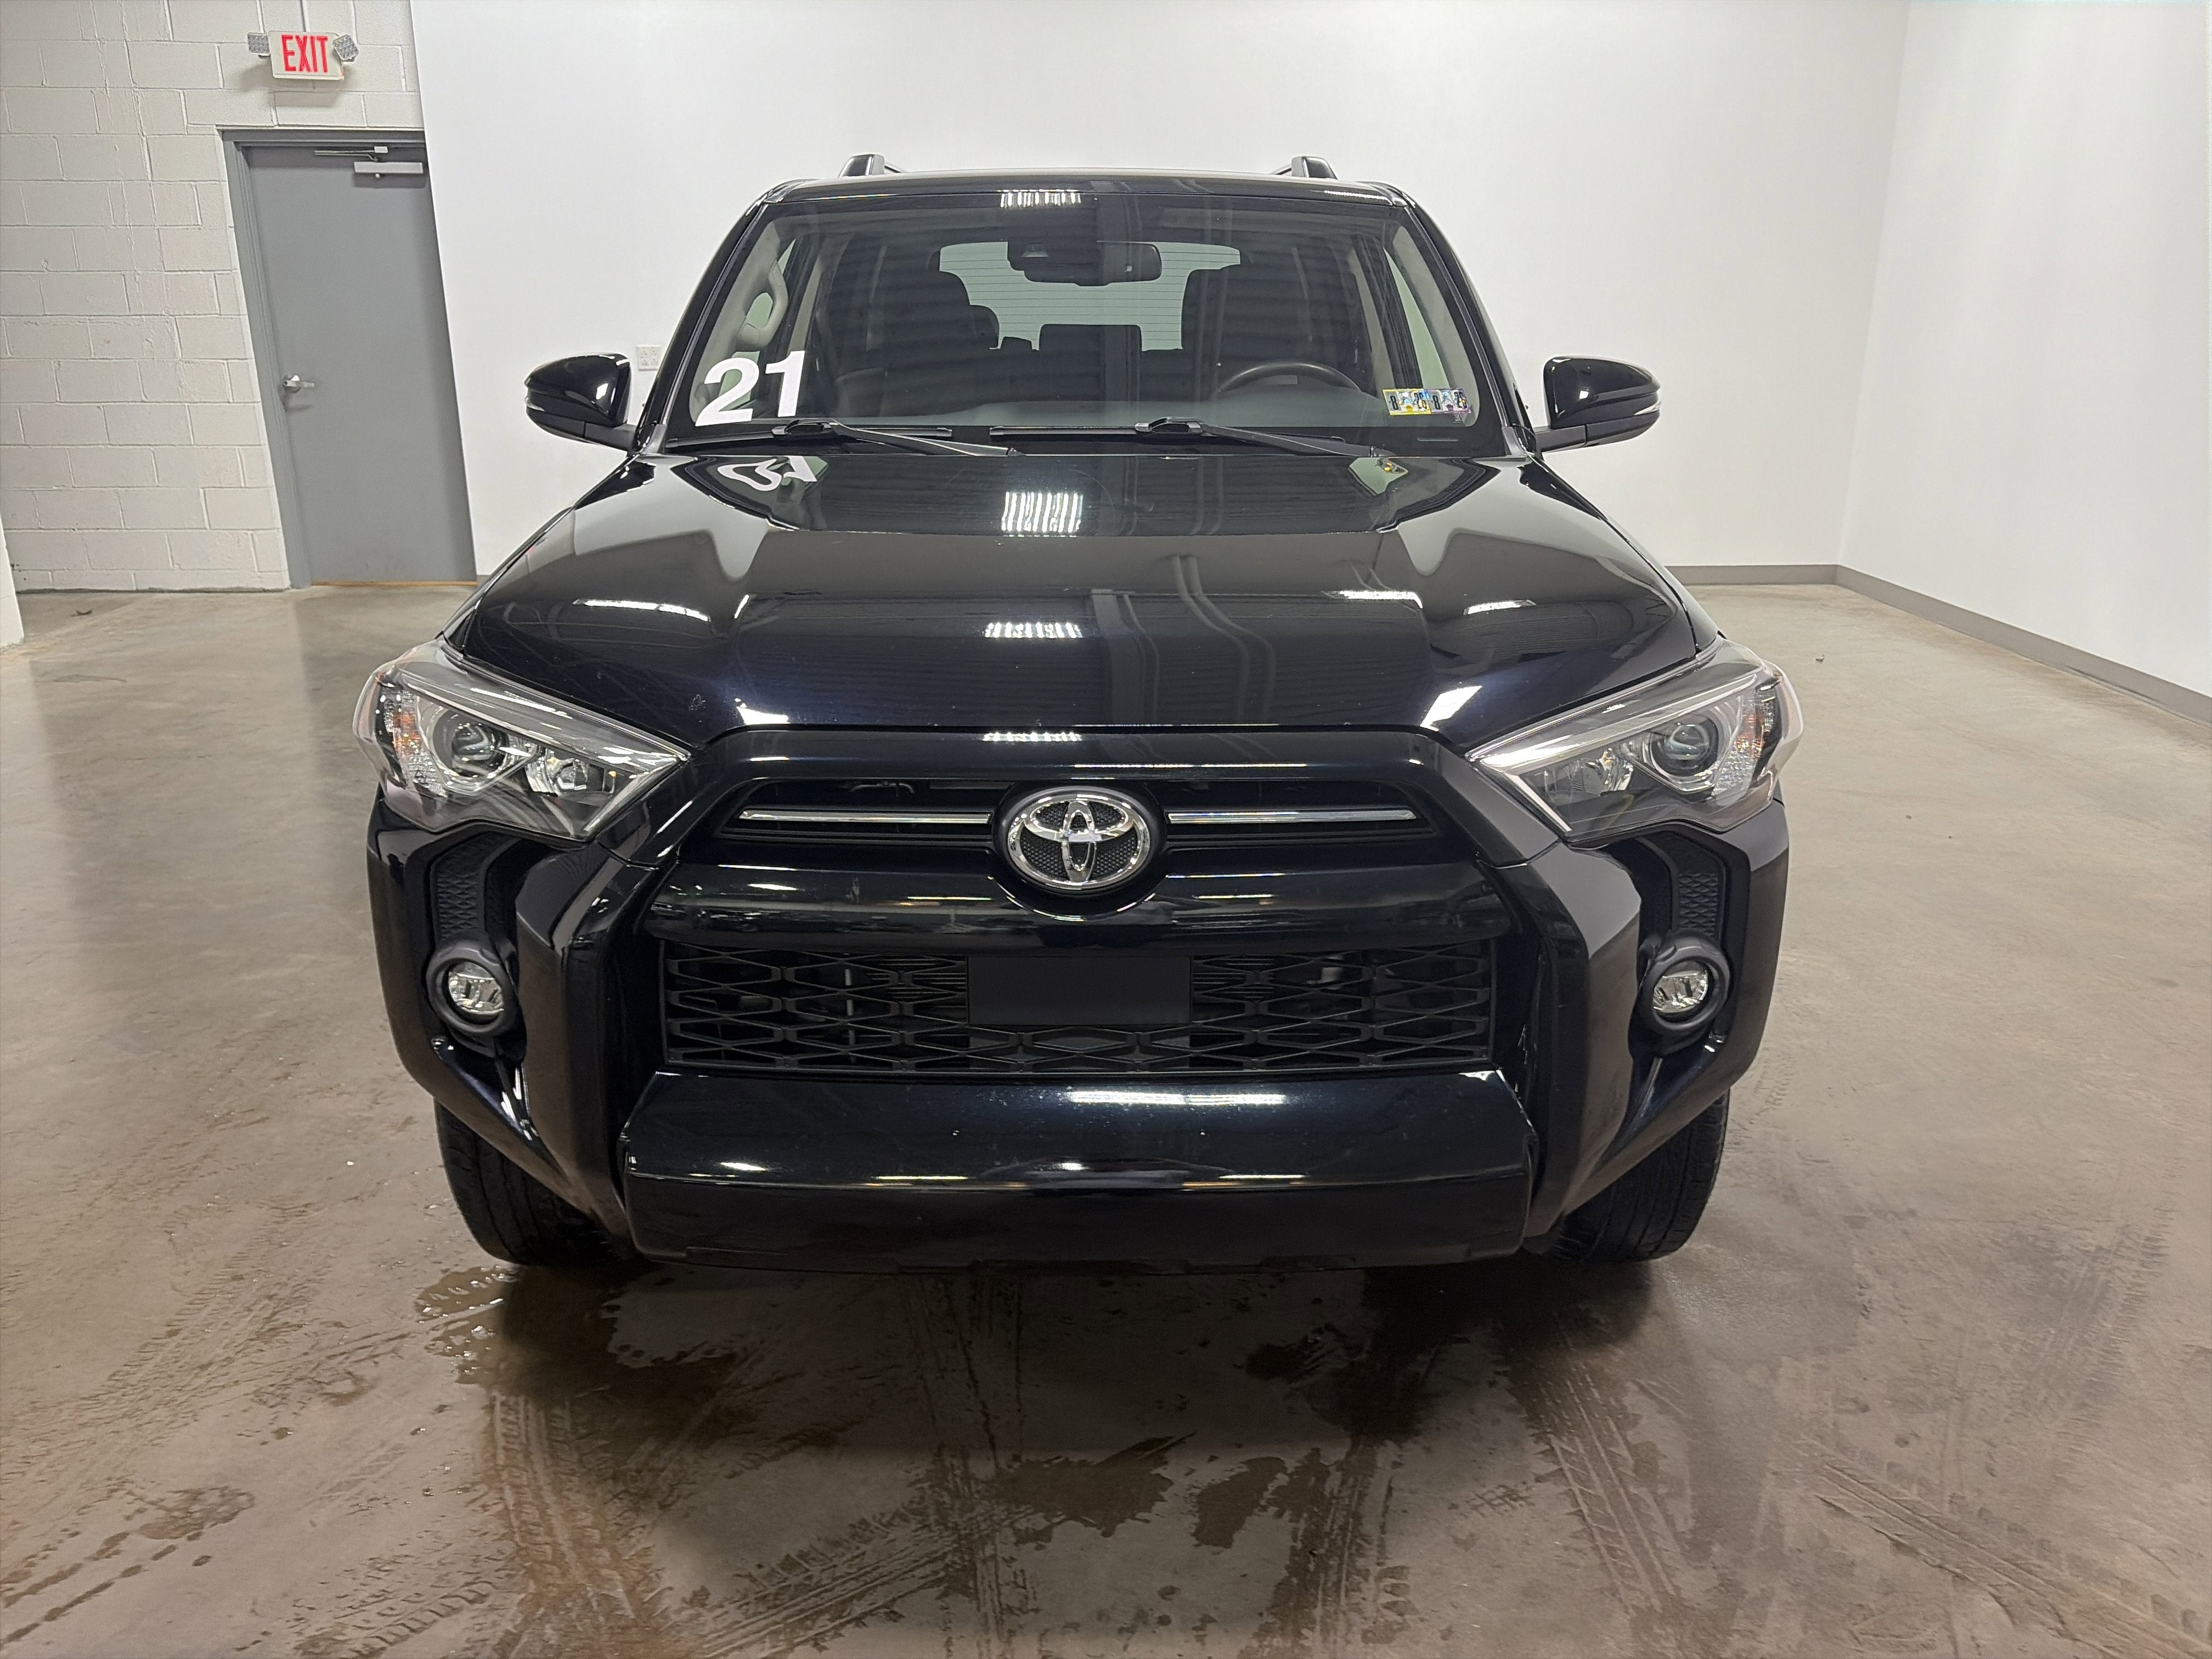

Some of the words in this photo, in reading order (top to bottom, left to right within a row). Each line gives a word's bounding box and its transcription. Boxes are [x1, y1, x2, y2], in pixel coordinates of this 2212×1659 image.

[281, 35, 328, 72] EXIT
[695, 351, 805, 426] 21
[1390, 395, 1399, 410] 8
[1432, 395, 1441, 410] 8
